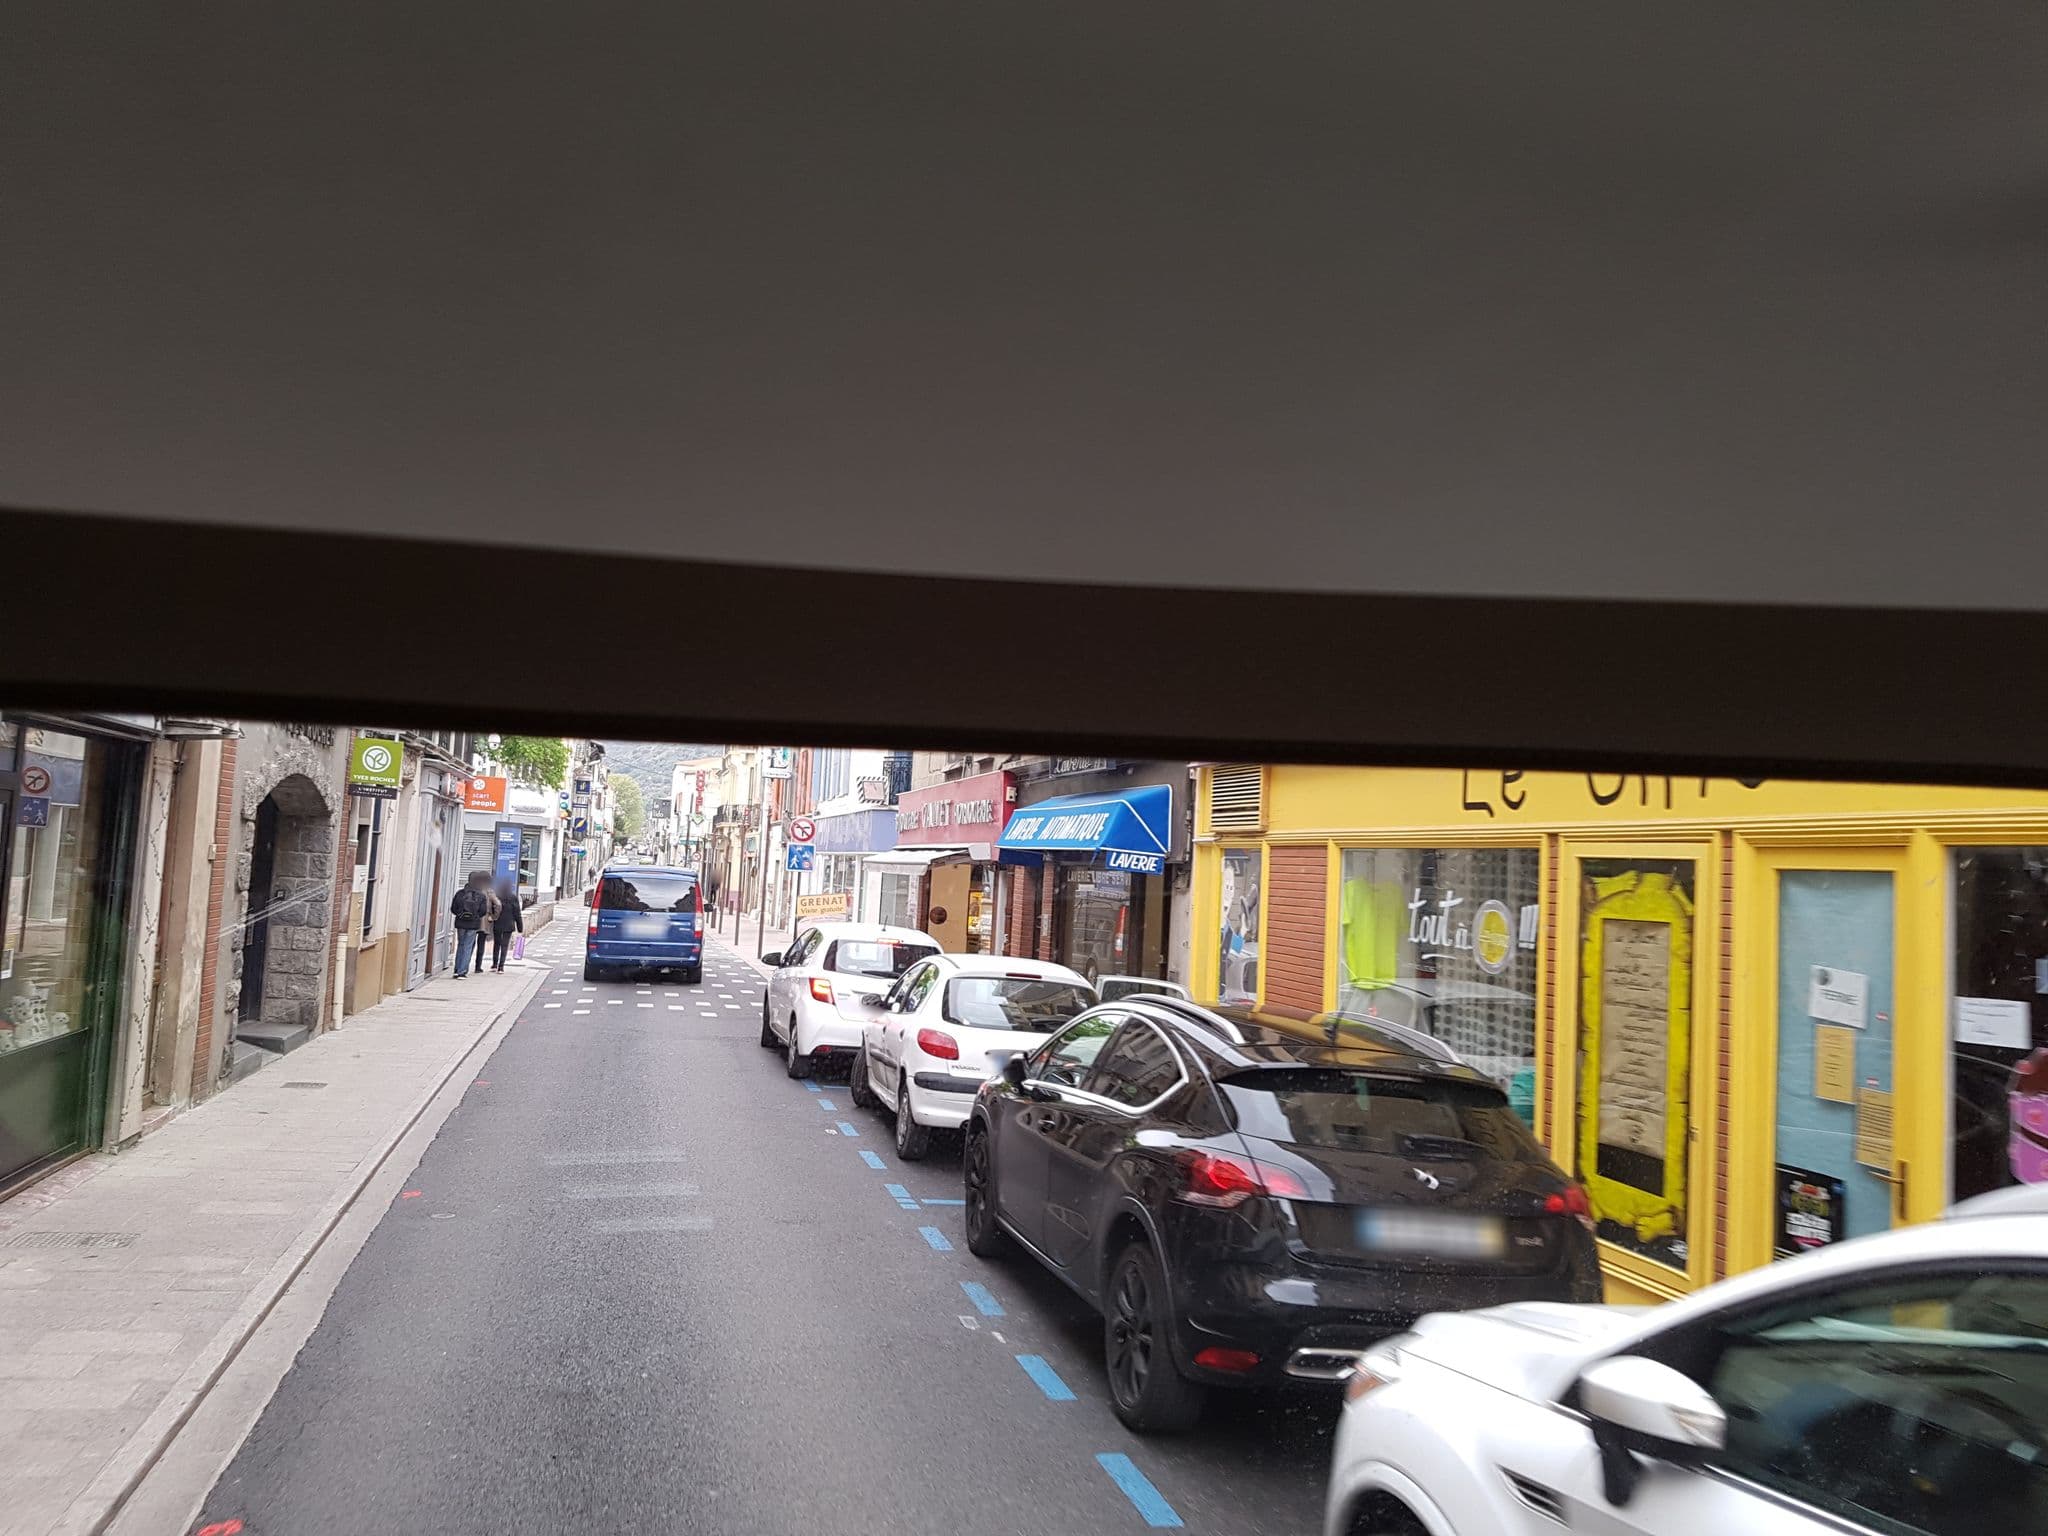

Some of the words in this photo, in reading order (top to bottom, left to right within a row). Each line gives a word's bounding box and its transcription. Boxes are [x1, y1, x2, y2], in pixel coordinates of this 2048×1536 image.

[370, 775, 396, 783] ROCHER
[471, 800, 497, 808] people
[1004, 817, 1045, 841] LAVERIE
[1037, 812, 1110, 842] AUTOMATIQUE
[1108, 851, 1160, 872] LAVERIE
[800, 896, 844, 907] GRENAT
[1408, 887, 1464, 947] tout
